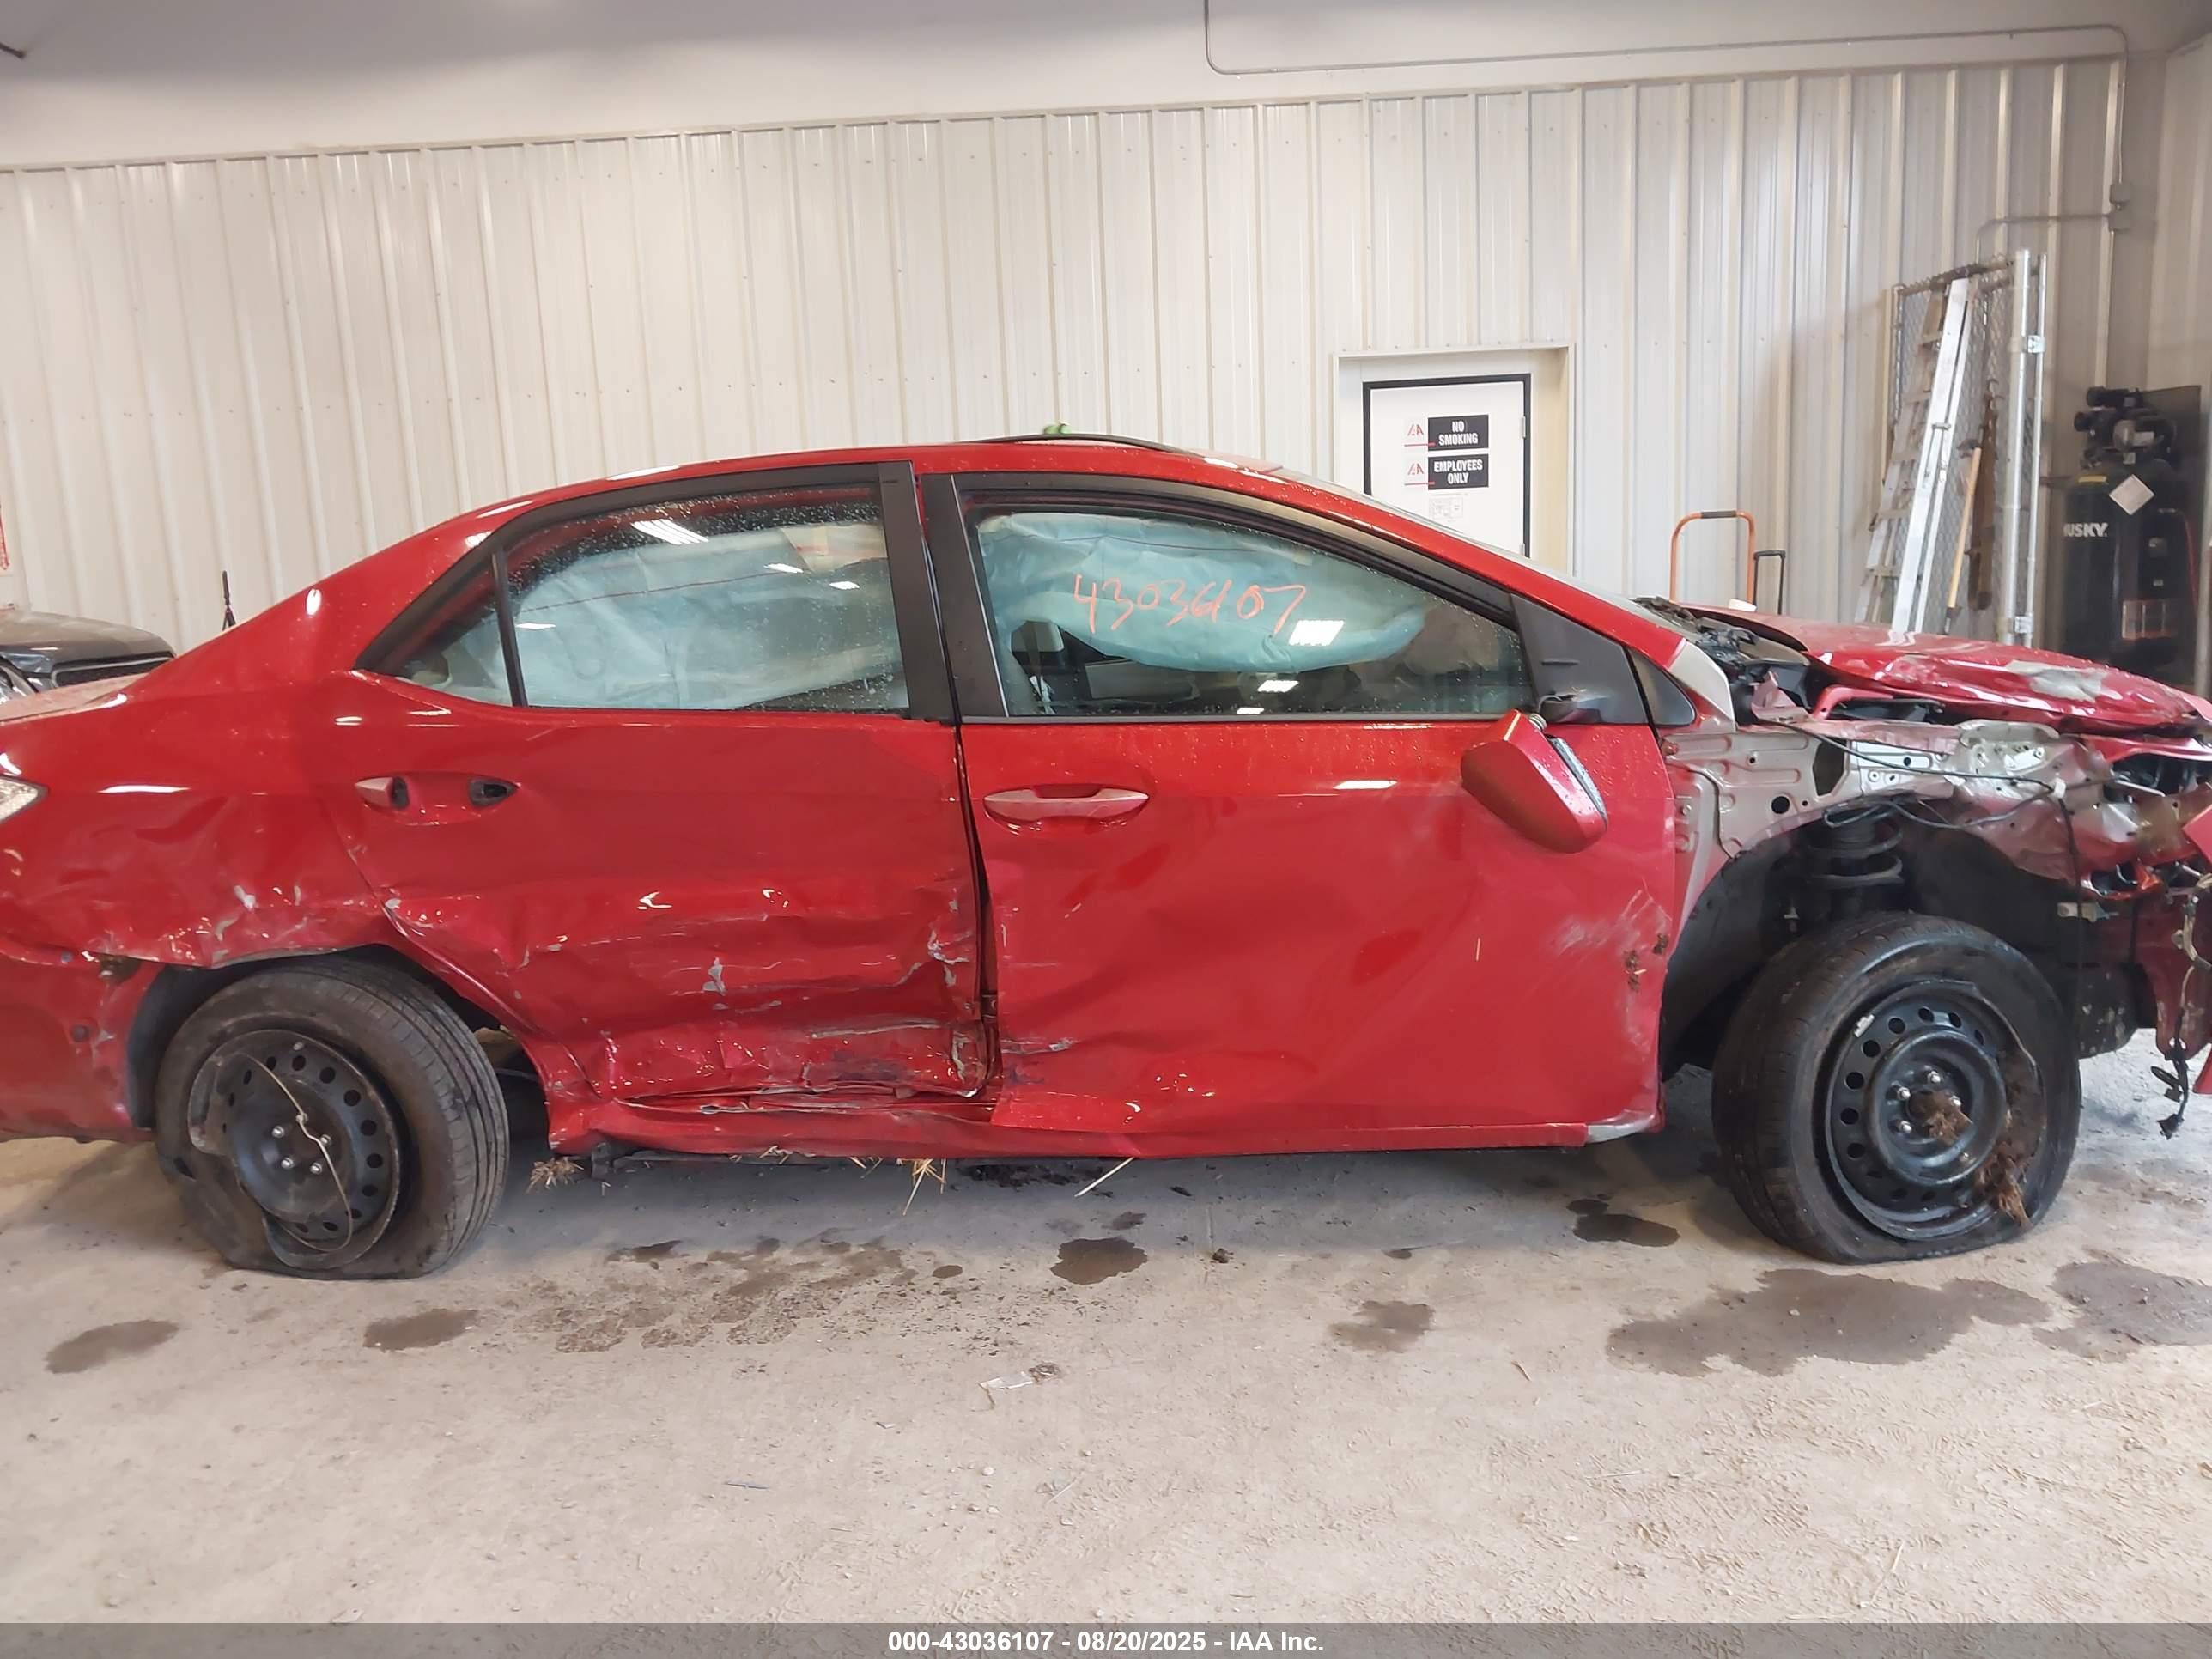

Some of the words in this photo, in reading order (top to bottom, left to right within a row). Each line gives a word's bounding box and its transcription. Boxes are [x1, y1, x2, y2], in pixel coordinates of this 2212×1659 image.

[1452, 421, 1465, 432] NO
[1438, 433, 1479, 446] SMOKING
[1433, 459, 1483, 472] EMPLOYEES
[1447, 472, 1469, 484] ONLY
